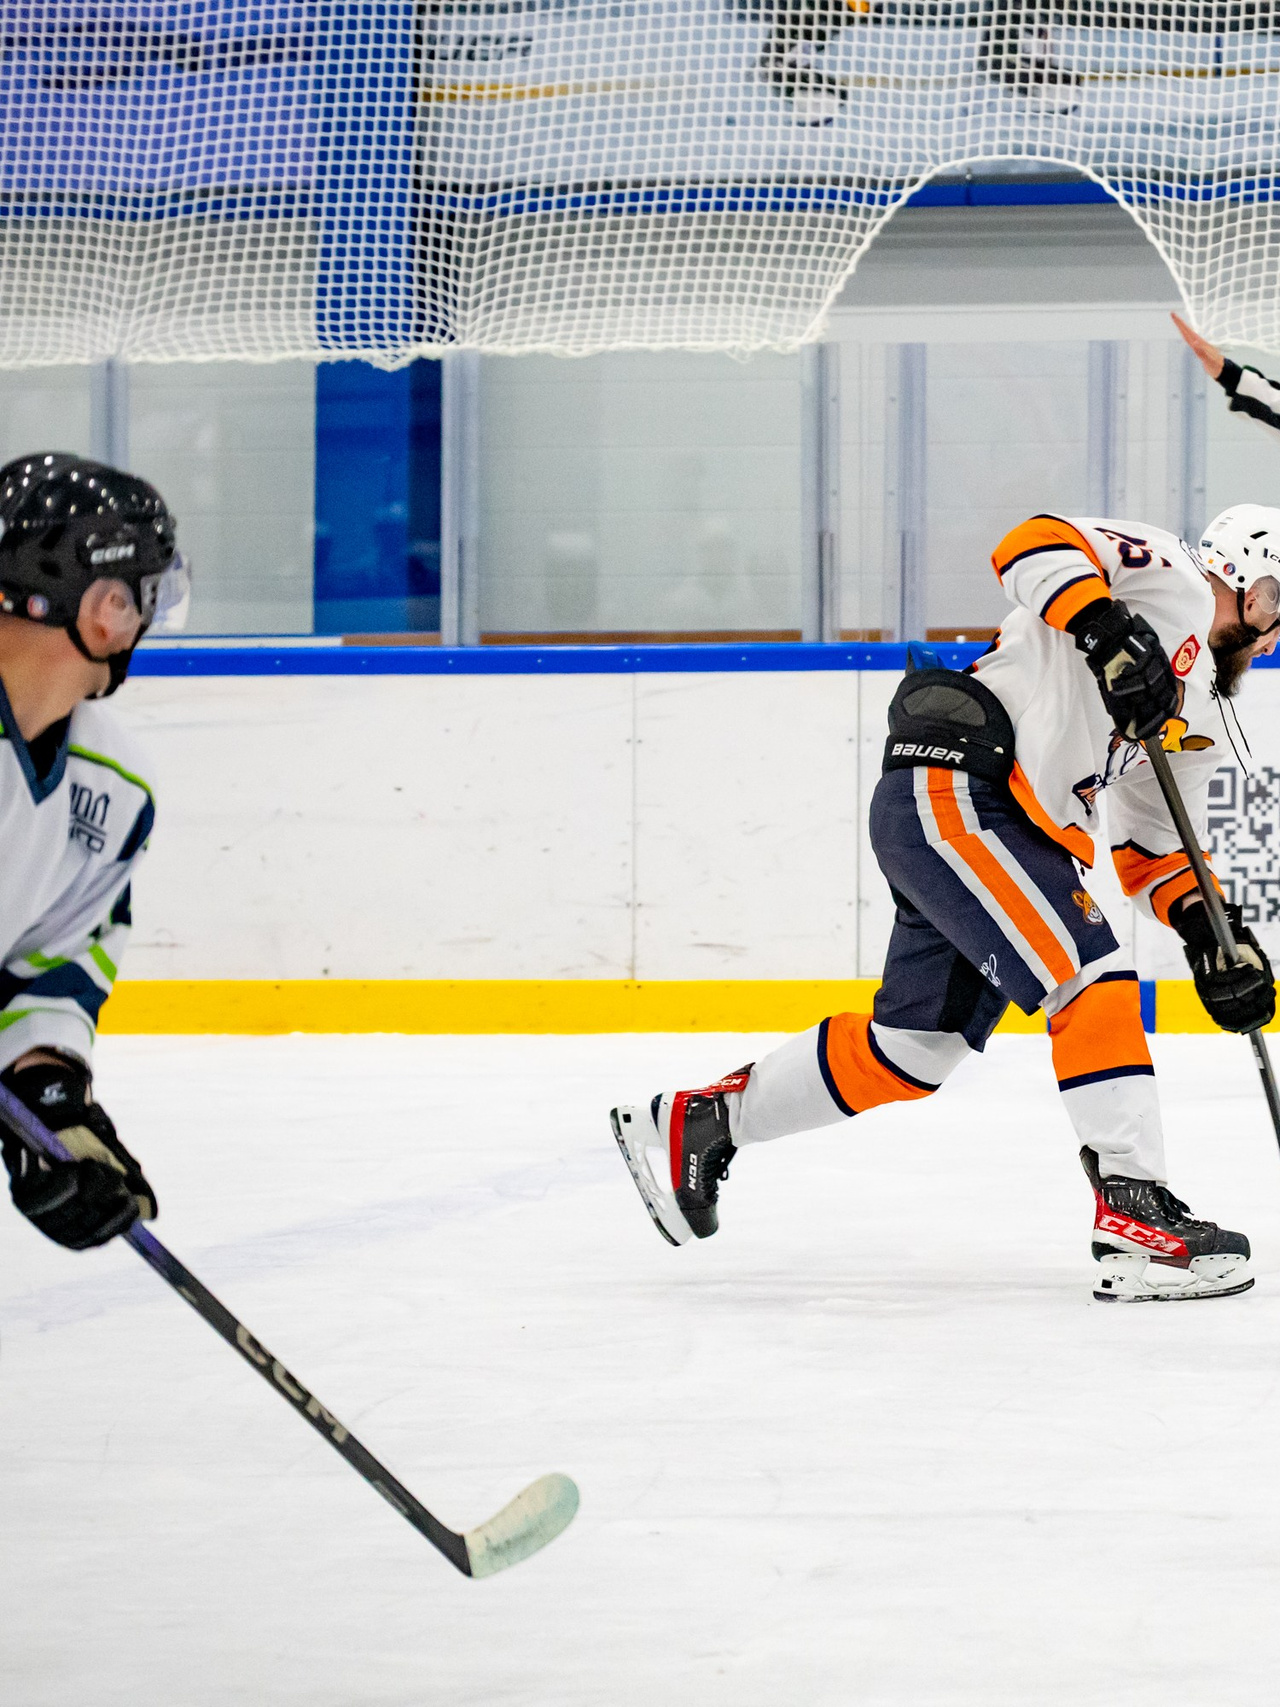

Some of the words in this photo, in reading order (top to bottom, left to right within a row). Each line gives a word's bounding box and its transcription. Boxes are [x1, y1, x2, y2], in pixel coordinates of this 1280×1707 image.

[90, 544, 136, 565] CCM
[688, 1153, 698, 1191] CCM
[1099, 1214, 1181, 1253] CCM
[236, 1323, 349, 1444] CCM
